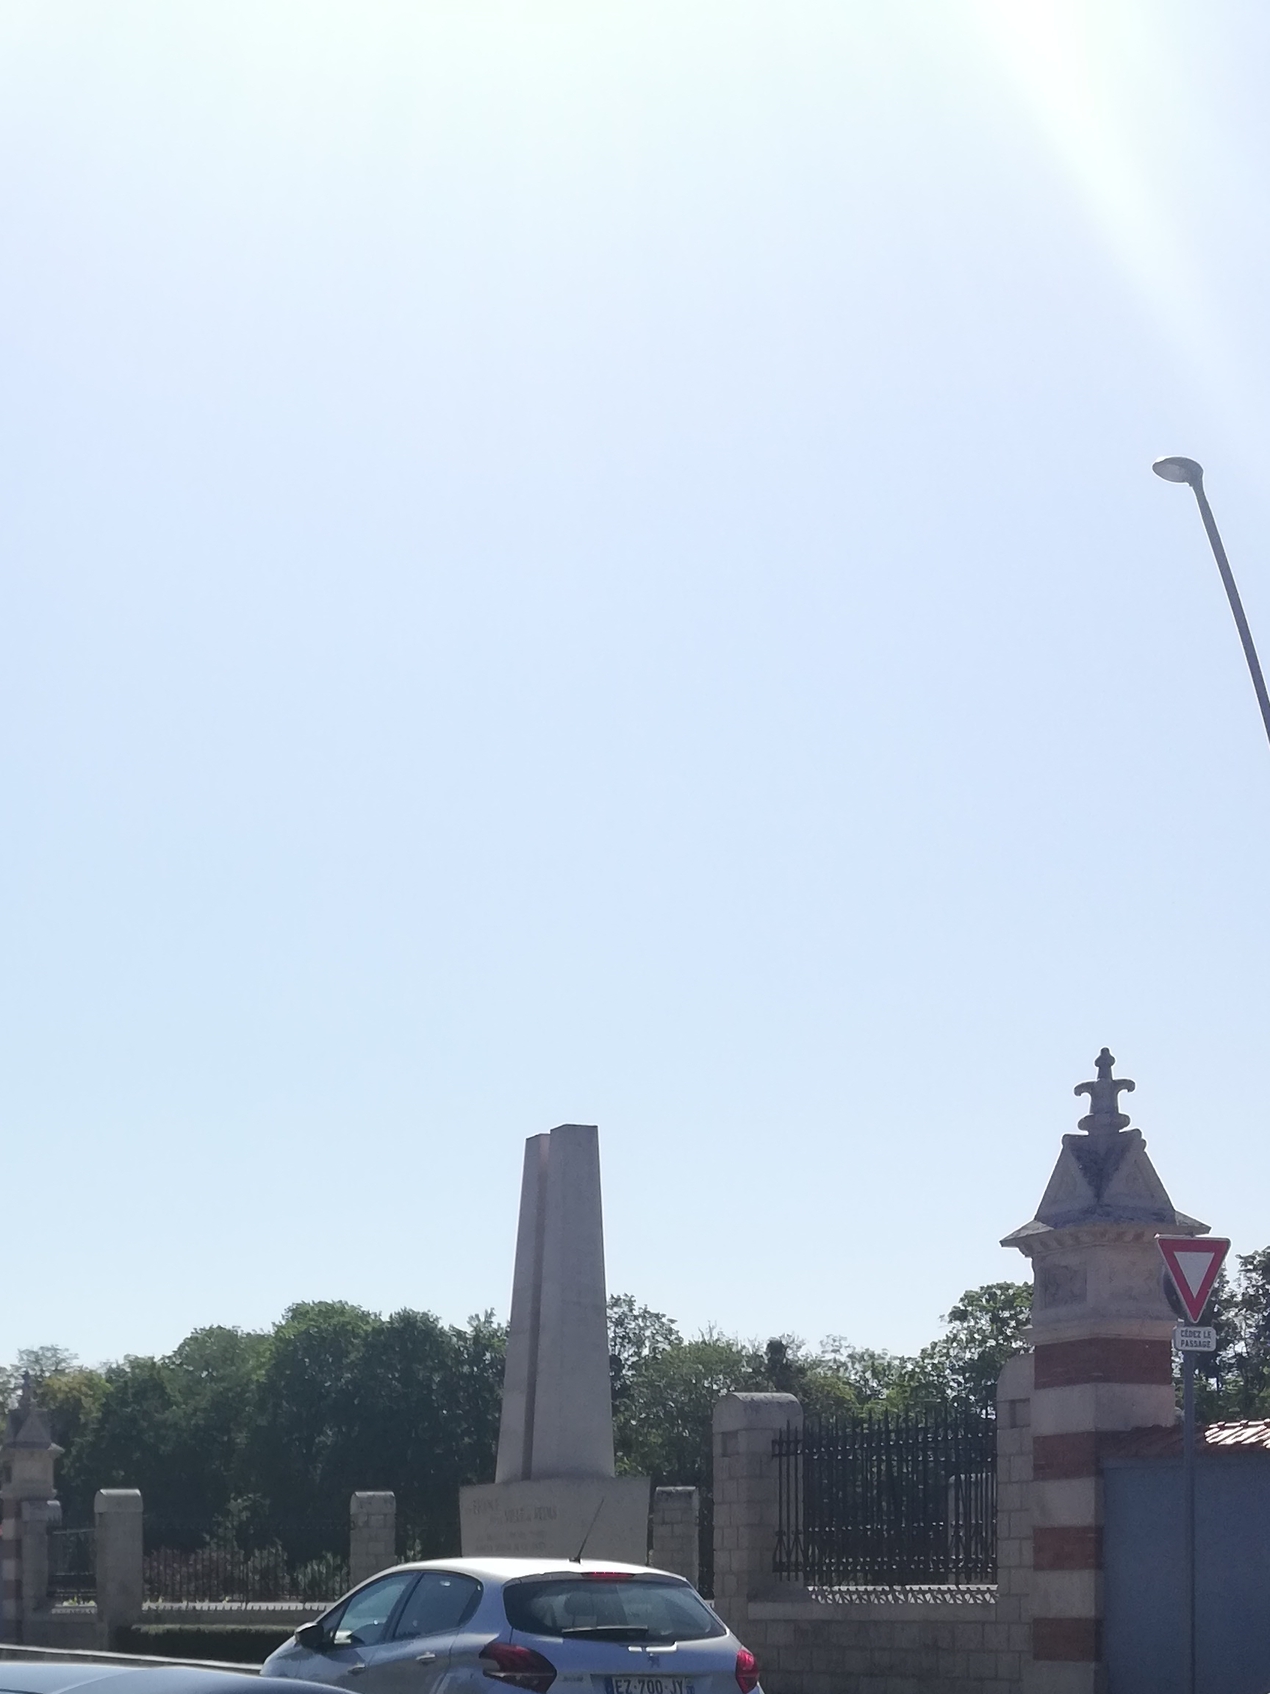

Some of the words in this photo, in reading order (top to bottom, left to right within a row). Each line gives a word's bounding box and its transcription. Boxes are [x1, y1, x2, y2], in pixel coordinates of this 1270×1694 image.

[1180, 1329, 1201, 1338] CÉDEZ
[1203, 1331, 1212, 1339] LE
[1180, 1340, 1211, 1348] PASSAGE
